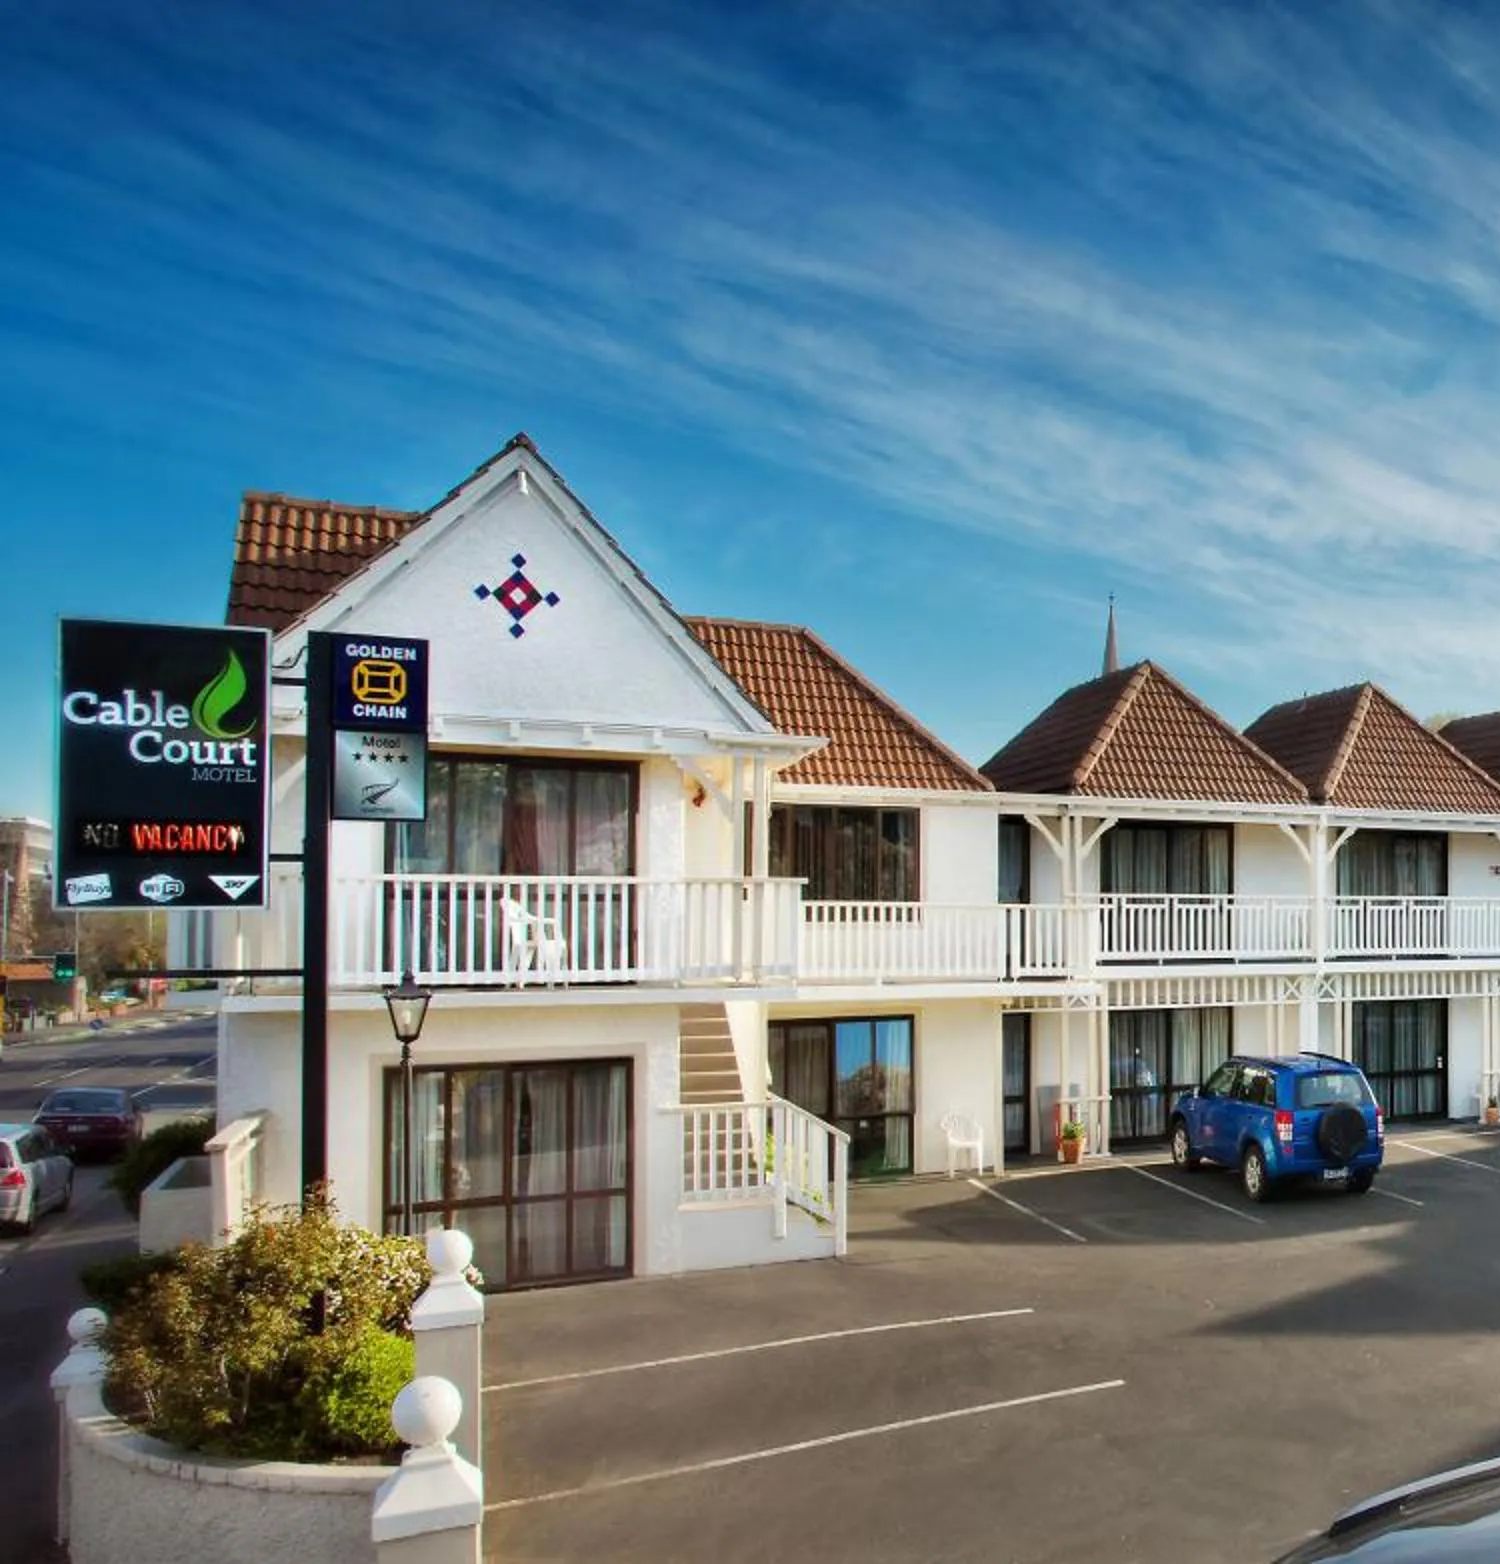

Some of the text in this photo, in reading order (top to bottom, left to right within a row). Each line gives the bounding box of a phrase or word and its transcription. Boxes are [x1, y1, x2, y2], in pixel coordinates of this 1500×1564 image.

[345, 643, 417, 661] GOLDEN
[63, 688, 190, 729] Cable
[352, 703, 407, 719] CHAIN
[129, 729, 257, 766] Court
[362, 735, 401, 749] Motel
[191, 767, 257, 783] MOTEL
[131, 823, 243, 851] VACANCY
